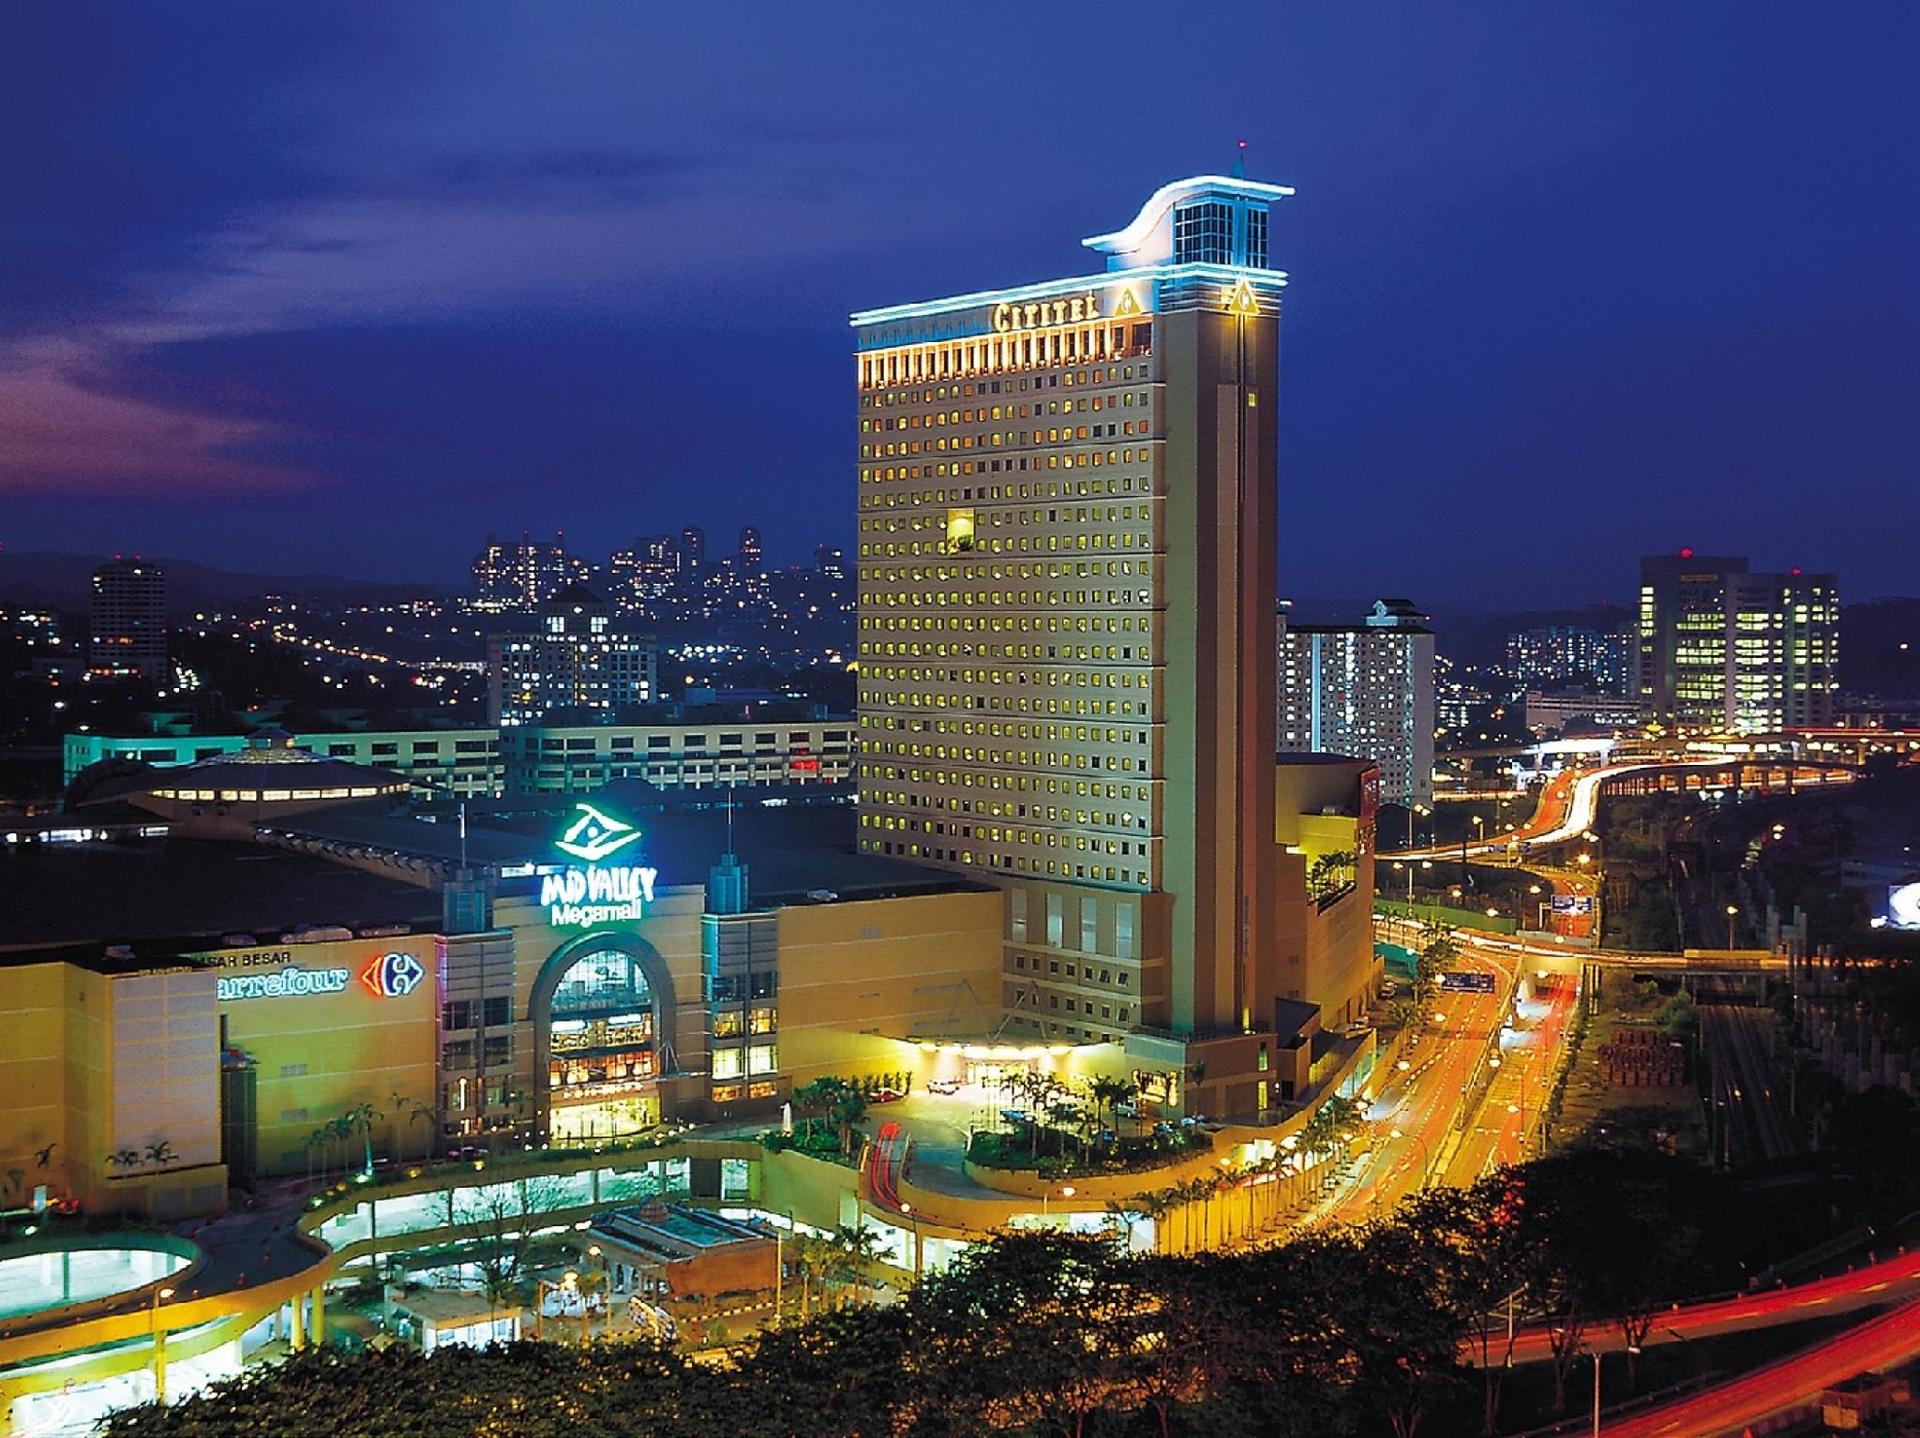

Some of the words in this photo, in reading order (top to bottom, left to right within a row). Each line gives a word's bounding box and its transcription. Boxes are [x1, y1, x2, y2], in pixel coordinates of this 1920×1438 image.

[993, 290, 1100, 333] CITITEL
[587, 865, 657, 902] VALLEY
[551, 898, 642, 928] Megamall
[242, 951, 291, 967] BESAR
